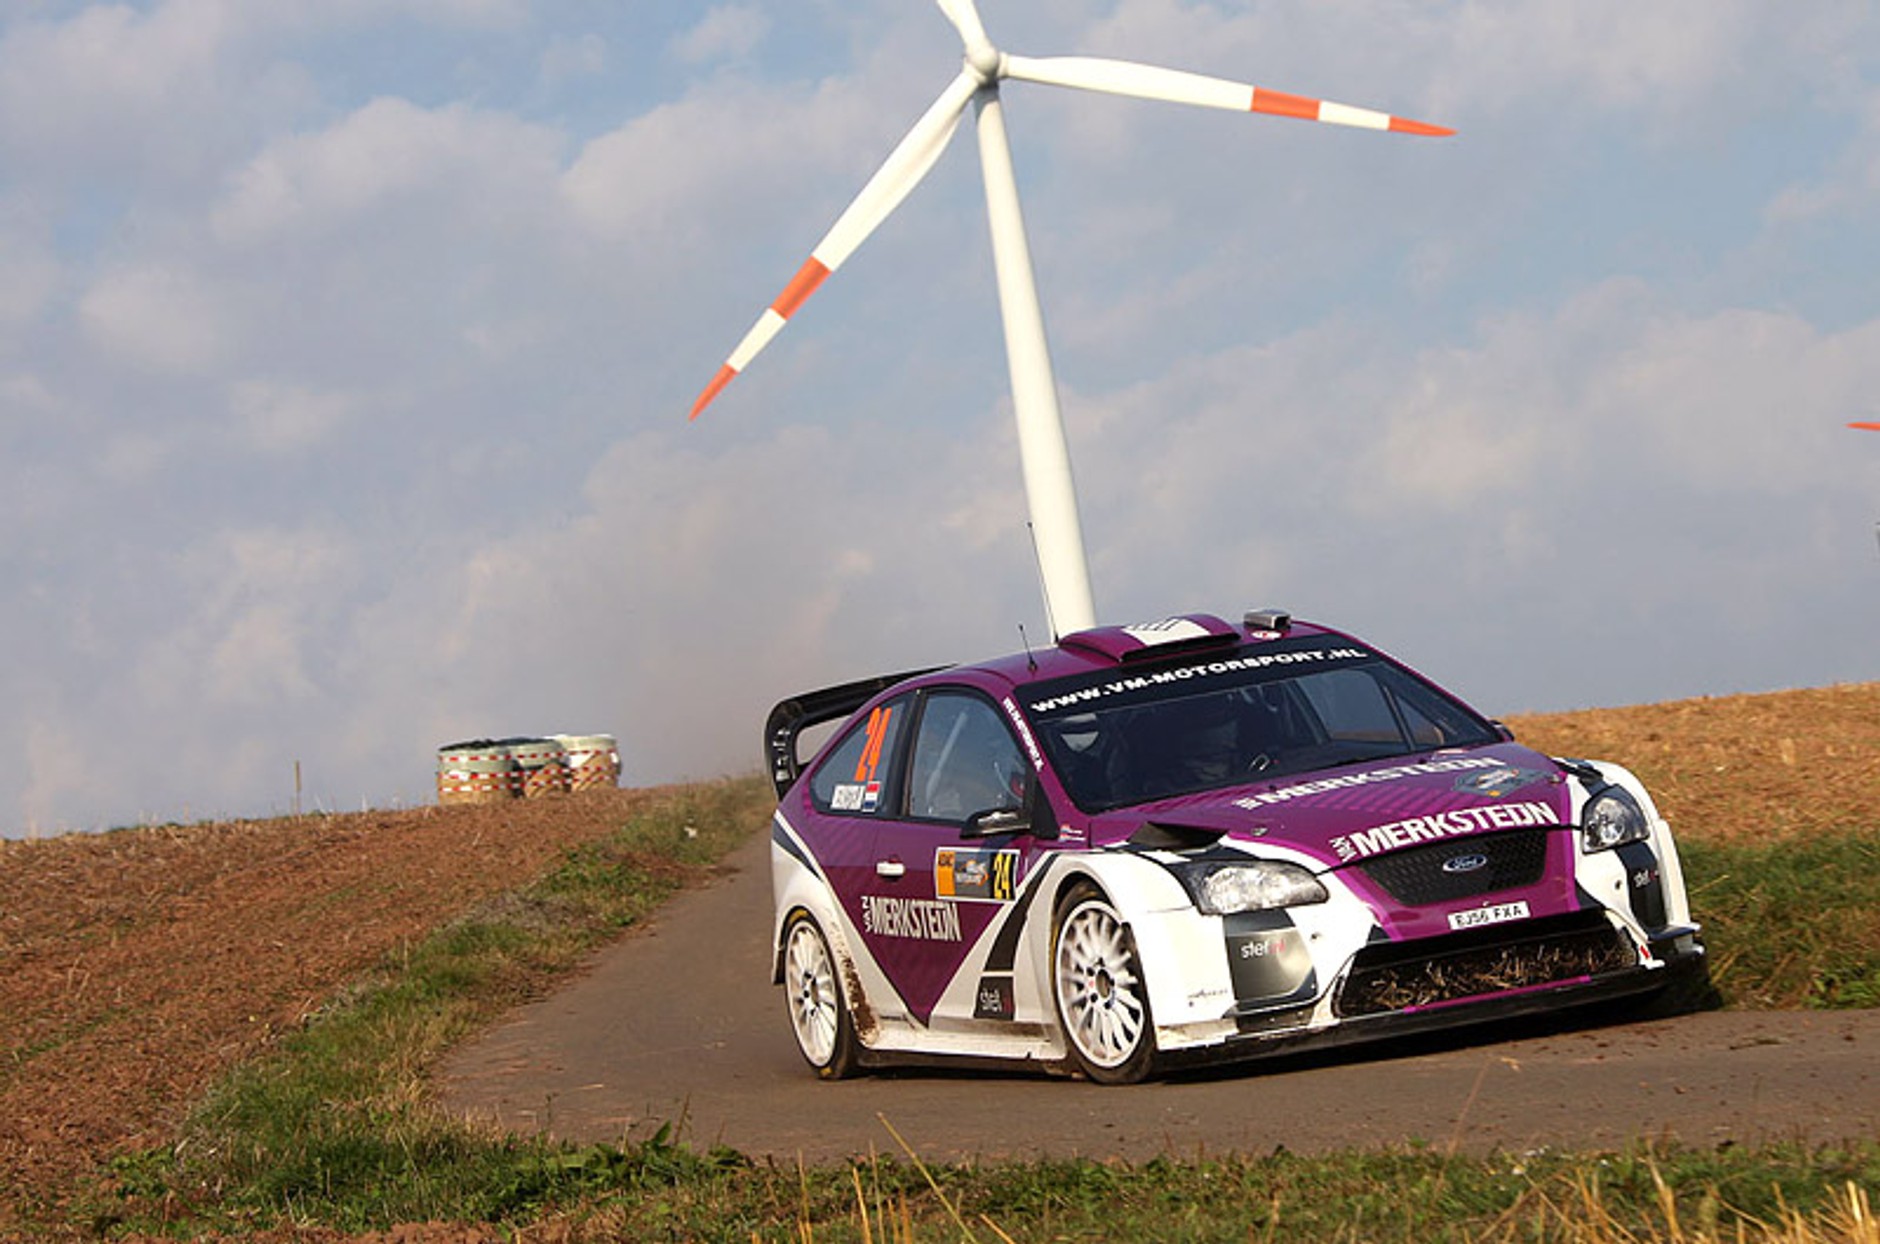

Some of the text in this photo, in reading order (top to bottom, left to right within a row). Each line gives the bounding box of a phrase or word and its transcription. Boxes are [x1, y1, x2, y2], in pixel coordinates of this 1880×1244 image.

[1031, 648, 1368, 713] WWW.VM-MOTORSPORT.NL
[993, 852, 1012, 900] 24
[1493, 904, 1524, 919] FXA
